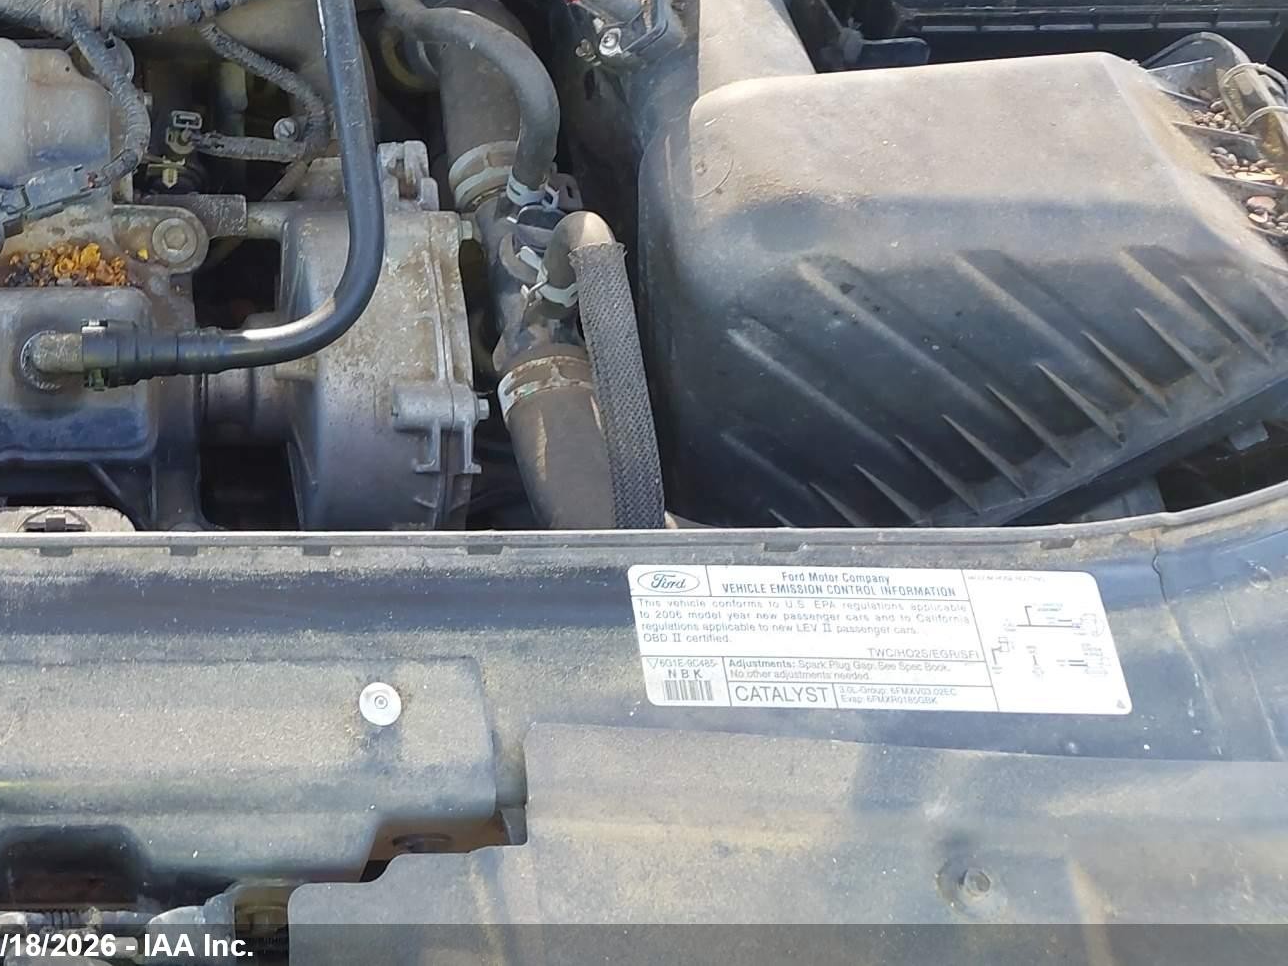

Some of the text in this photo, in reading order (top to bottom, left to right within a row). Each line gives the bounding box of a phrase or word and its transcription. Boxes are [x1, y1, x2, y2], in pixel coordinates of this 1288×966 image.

[651, 574, 686, 589] Ford
[782, 572, 890, 585] Ford Motor Company
[722, 583, 956, 596] VEHICLE EMISSION CONTROL INFORMATION
[638, 598, 661, 607] This
[668, 599, 706, 607] vehicle
[712, 599, 763, 608] conforms
[814, 601, 835, 609] EPA
[842, 601, 904, 611] regulations
[912, 603, 966, 614] applicable
[639, 610, 650, 619] to
[688, 610, 722, 619] model
[727, 612, 750, 621] year
[784, 613, 840, 623] passenger
[874, 613, 894, 622] and
[916, 614, 969, 624] California
[642, 623, 699, 632] regulations
[703, 623, 756, 633] applicable
[759, 623, 768, 631] to
[772, 624, 792, 632] new
[797, 624, 817, 632] LEV
[837, 625, 890, 636] passenger
[643, 633, 667, 642] OBD
[673, 633, 681, 642] II
[729, 659, 795, 669] Adjustments:
[798, 660, 826, 670] Spark
[829, 660, 851, 671] Plug
[899, 661, 922, 672] Spec
[668, 669, 677, 678] N
[682, 670, 689, 679] B
[694, 669, 703, 679] K
[730, 669, 744, 678] No
[747, 670, 771, 678] other
[774, 671, 831, 681] adjustments
[735, 686, 828, 702] CATALYST
